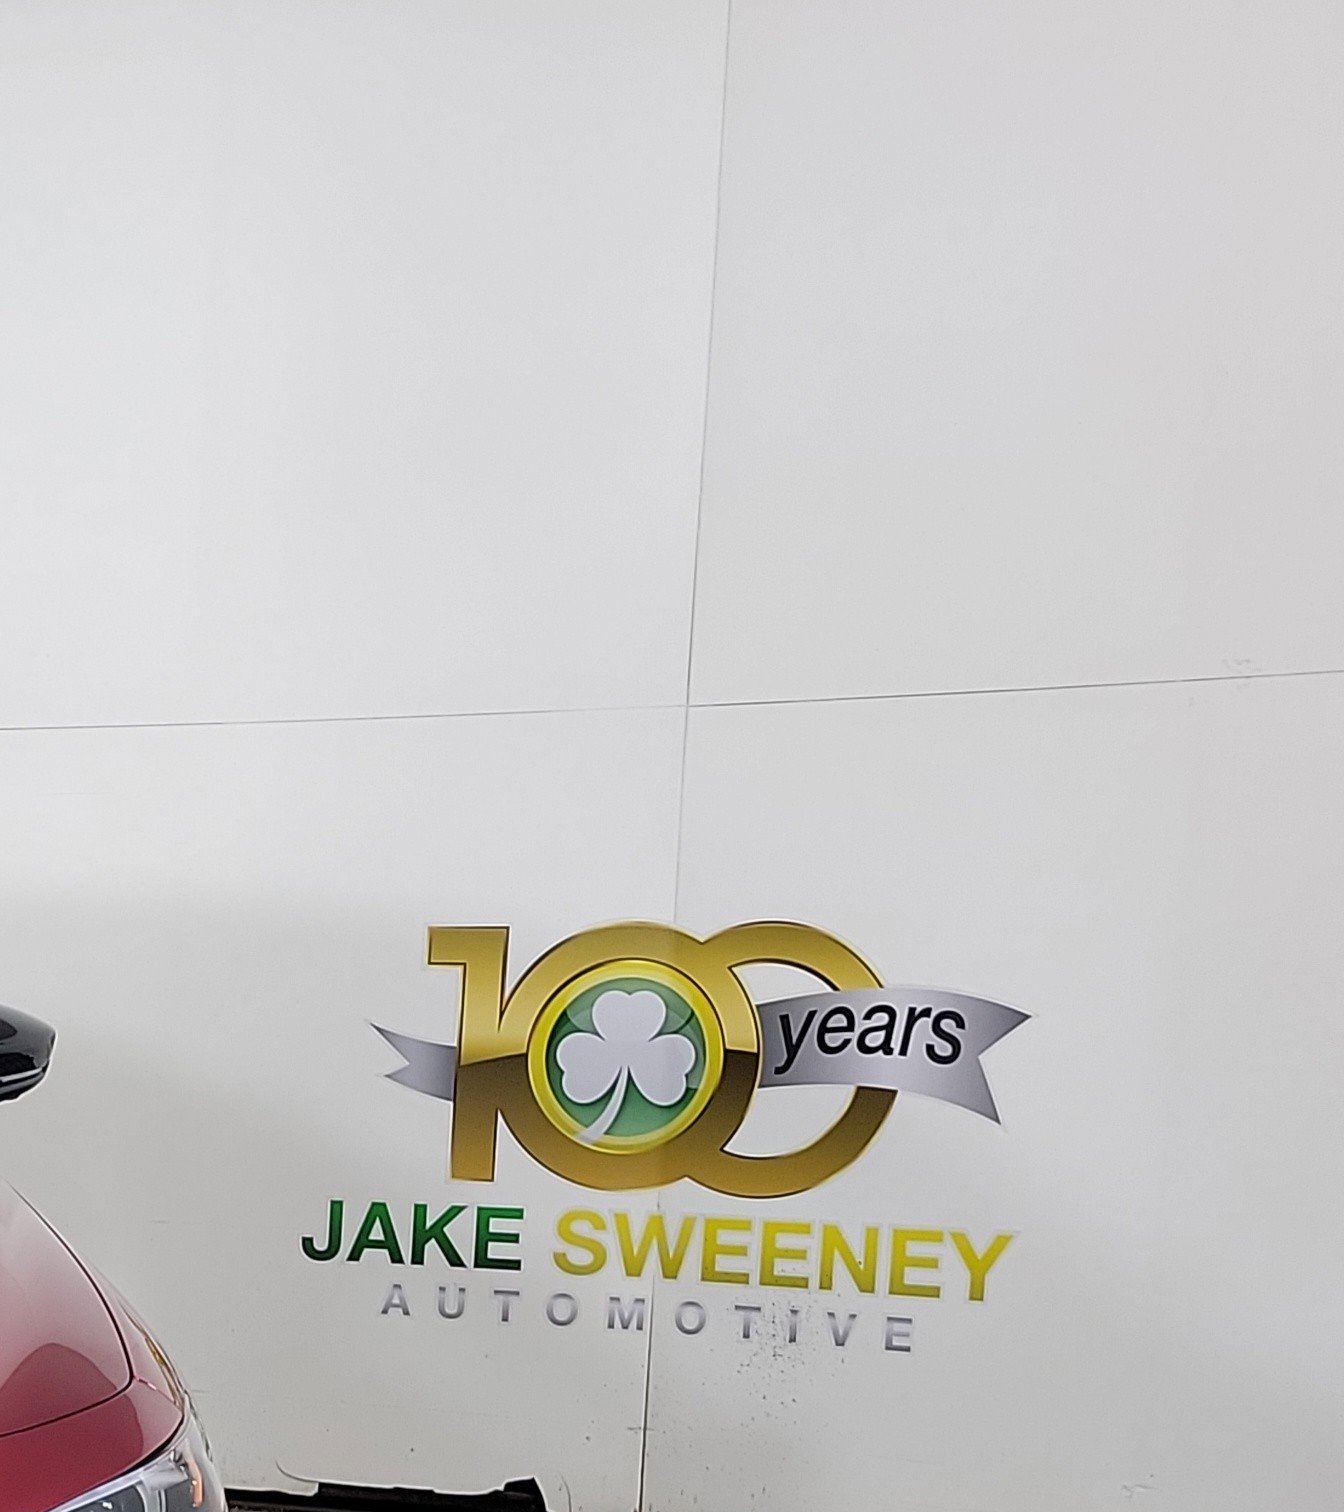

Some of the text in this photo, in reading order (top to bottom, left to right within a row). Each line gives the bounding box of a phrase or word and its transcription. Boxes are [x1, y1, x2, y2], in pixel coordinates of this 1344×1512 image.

[427, 920, 966, 1199] 100 years
[301, 1200, 1012, 1301] JAKE SWEENEY
[381, 1283, 912, 1352] AUTOMOTIVE
